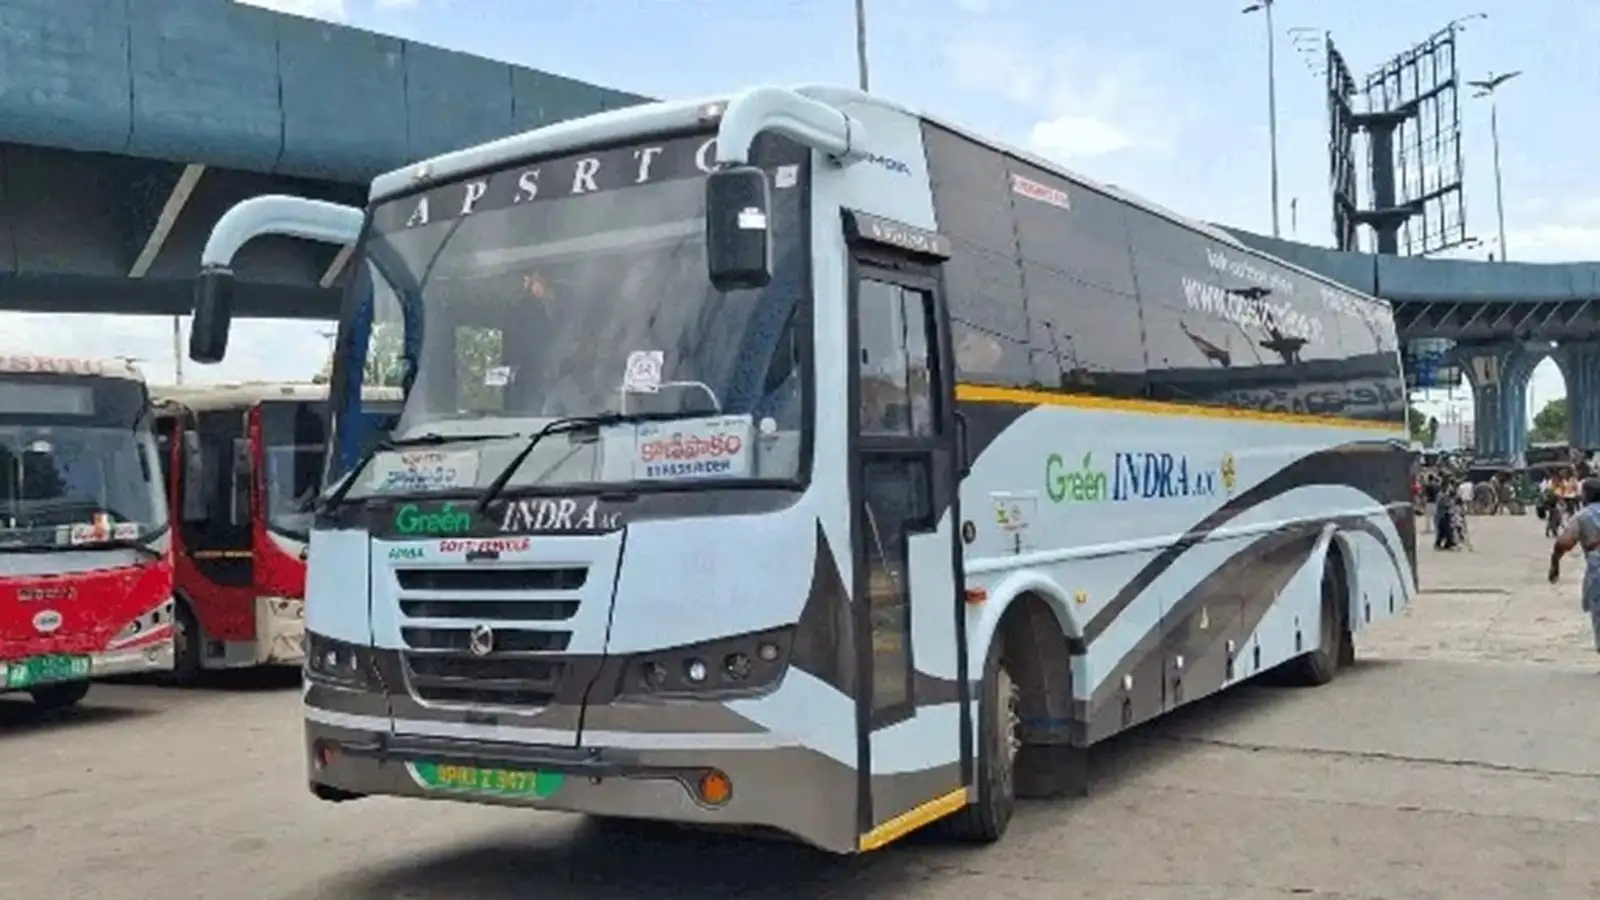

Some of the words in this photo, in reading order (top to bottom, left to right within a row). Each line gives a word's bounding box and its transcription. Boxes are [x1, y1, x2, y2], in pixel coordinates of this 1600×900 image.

[1046, 452, 1107, 503] Green
[1111, 452, 1188, 501] INDRA
[500, 499, 599, 531] INDRA
